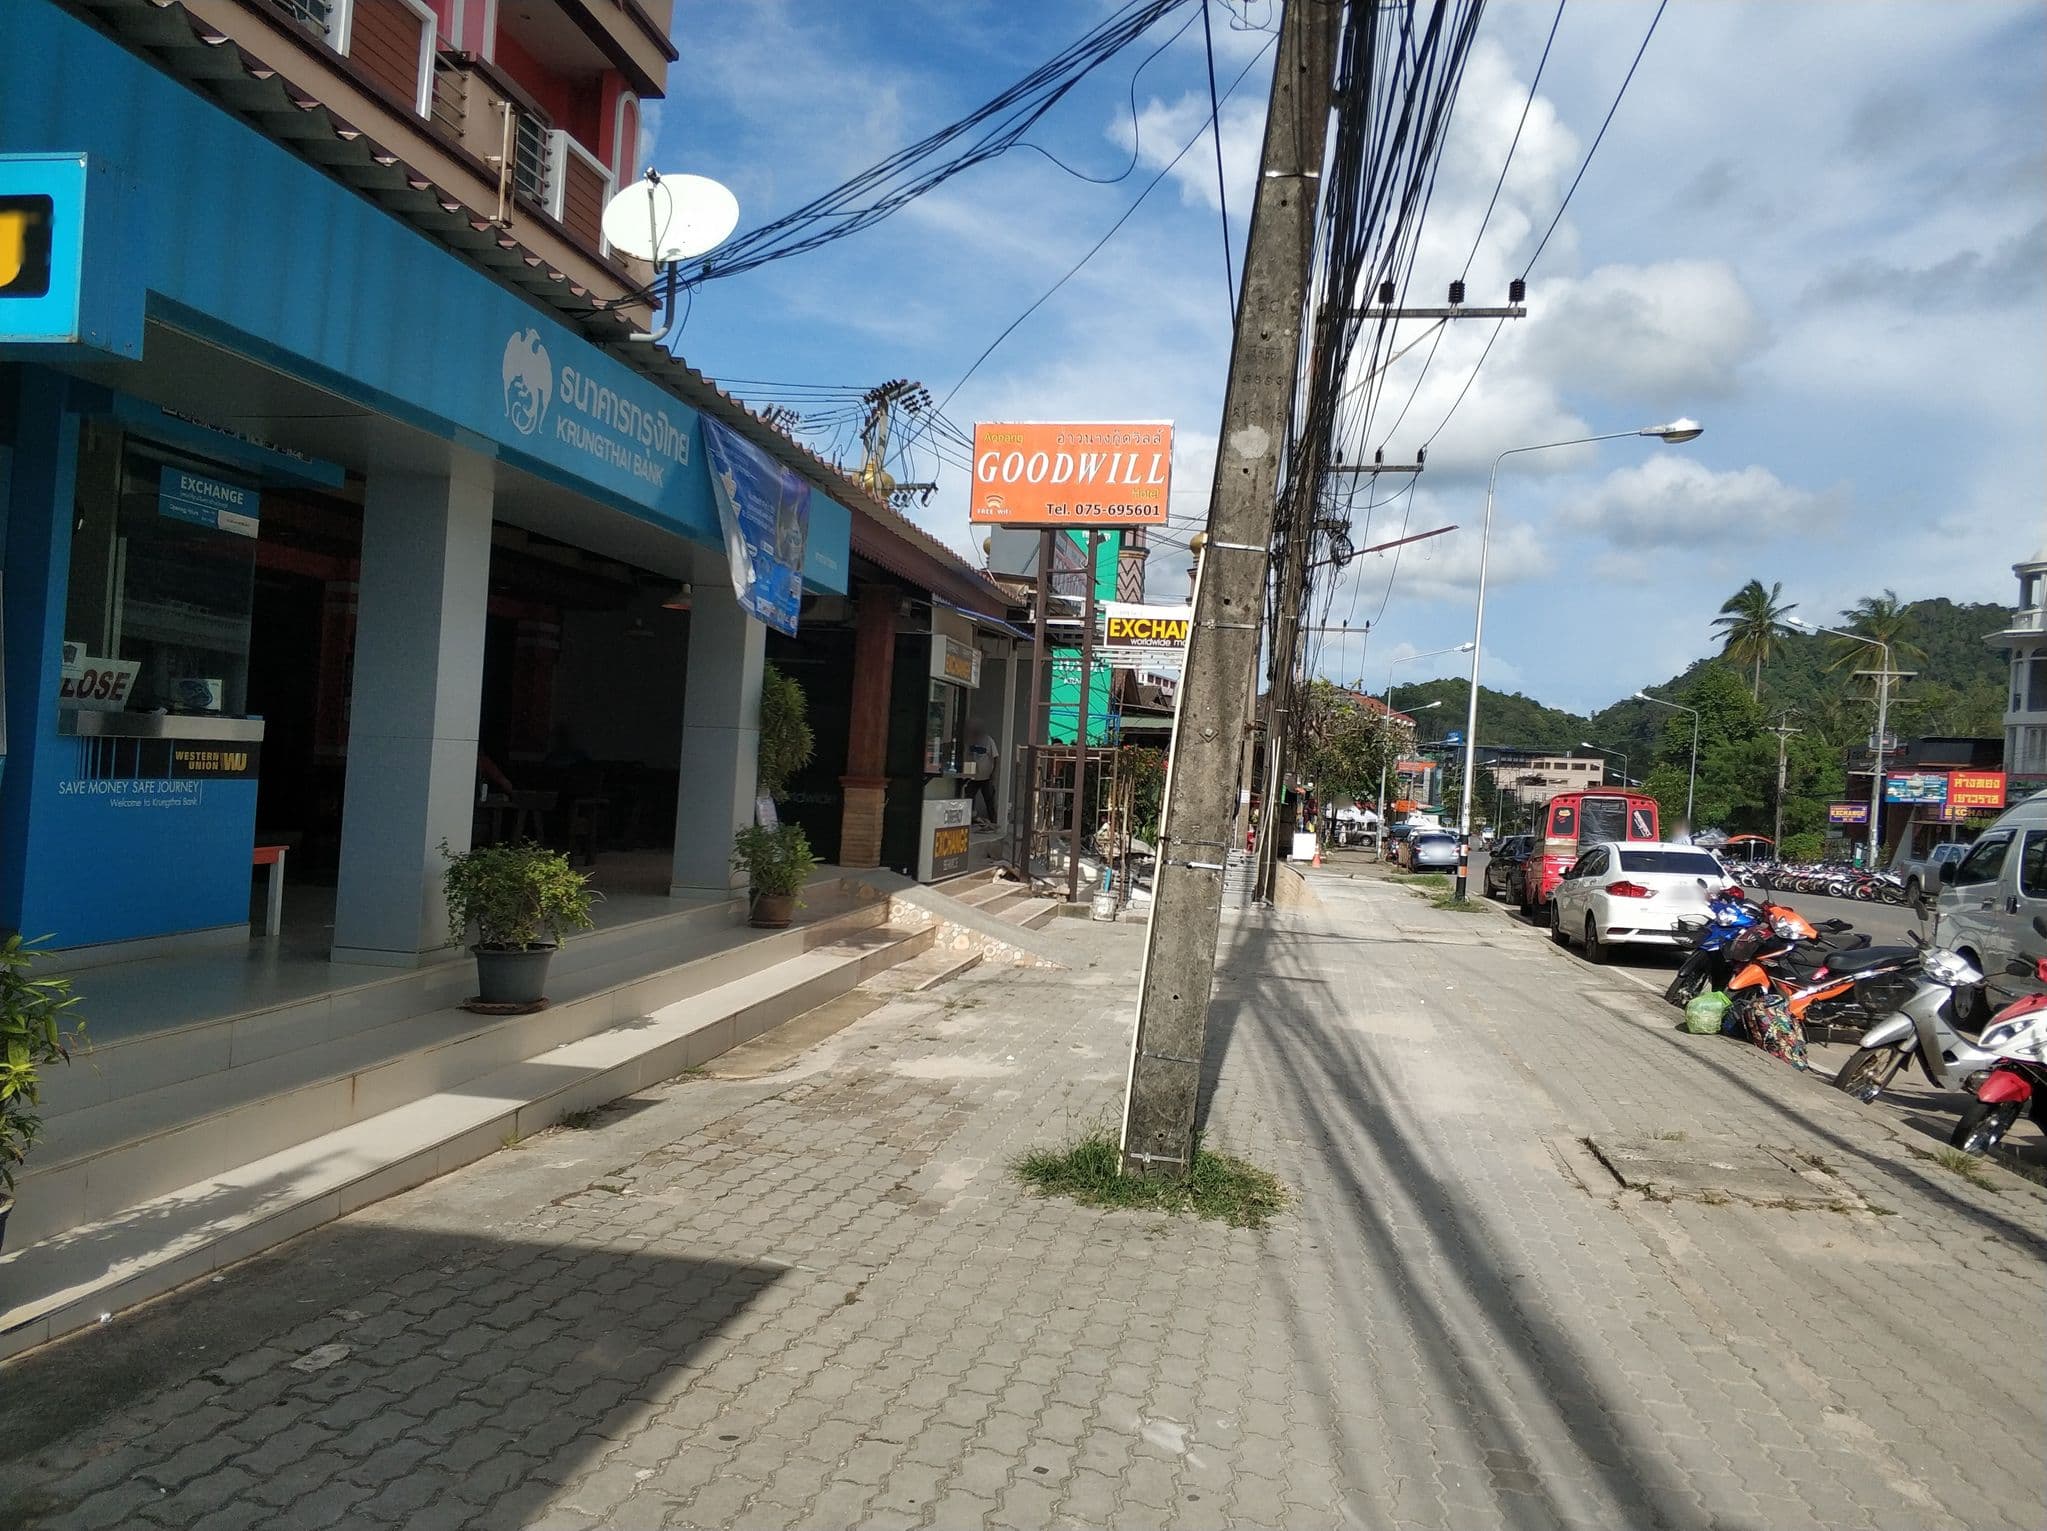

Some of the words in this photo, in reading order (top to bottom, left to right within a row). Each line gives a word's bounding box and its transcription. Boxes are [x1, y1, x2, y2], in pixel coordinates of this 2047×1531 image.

[560, 366, 690, 467] ธนาคารกรุงไทย
[556, 415, 632, 473] KRUNGTHAI
[633, 453, 665, 488] BANK
[977, 451, 1166, 485] GOODWILL
[180, 475, 244, 505] EXCHANGE
[1132, 488, 1160, 498] Hotel
[976, 507, 994, 515] FREE
[1047, 503, 1070, 516] Tel.
[1075, 504, 1160, 516] 075-695601
[1130, 638, 1171, 647] worldwide
[175, 751, 219, 761] WESTERN
[188, 761, 219, 770] UNION
[58, 781, 86, 794] SAVE
[88, 781, 129, 794] MONEY
[132, 780, 155, 793] SAFE
[157, 780, 199, 793] JOURNEY
[110, 798, 142, 808] Welcome
[143, 799, 151, 807] to
